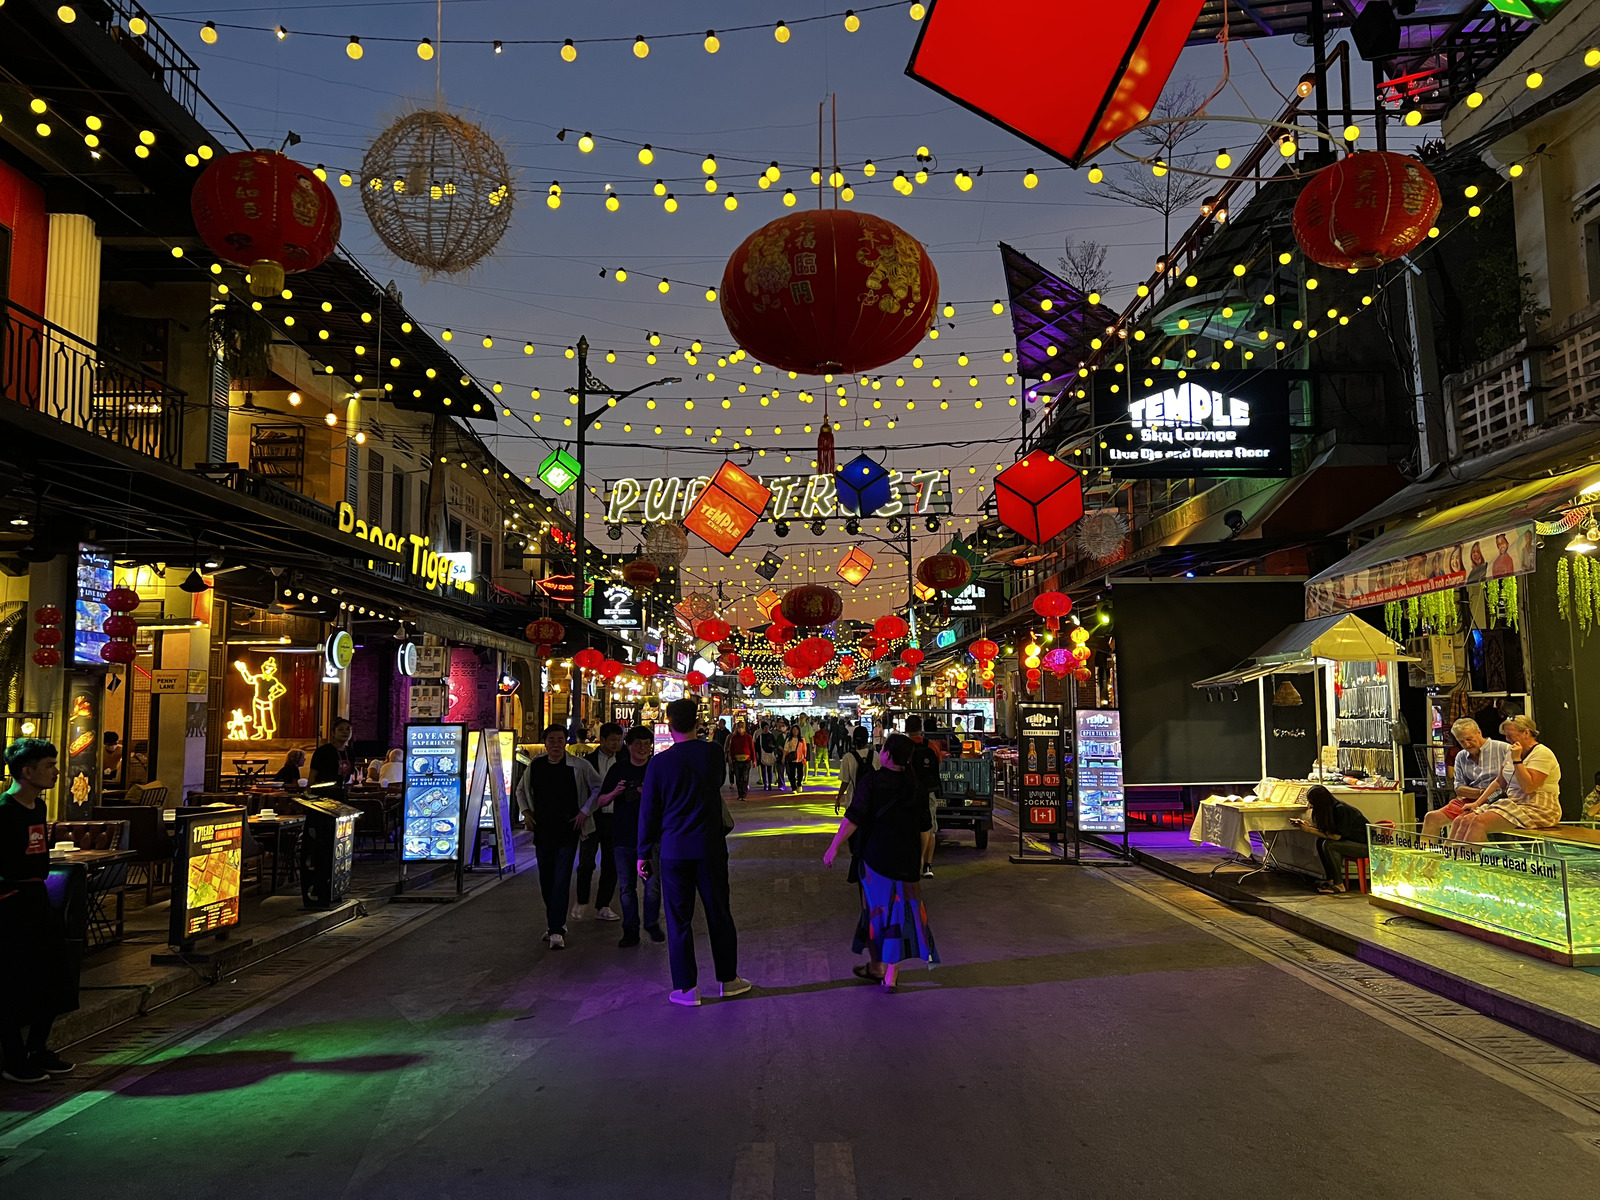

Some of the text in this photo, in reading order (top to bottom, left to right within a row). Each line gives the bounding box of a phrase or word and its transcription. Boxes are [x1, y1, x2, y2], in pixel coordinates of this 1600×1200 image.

[1128, 382, 1250, 428] TEMPLE
[1140, 428, 1236, 444] Sky Lounge
[1192, 448, 1233, 458] Dance
[757, 470, 941, 518] TRET
[700, 504, 742, 538] TEMPLE
[409, 533, 456, 590] Tiger
[940, 584, 986, 598] TPLE
[1384, 589, 1398, 600] make
[1398, 588, 1406, 600] you
[1407, 584, 1422, 596] happy
[1436, 578, 1444, 588] not
[1446, 574, 1464, 586] charge
[615, 708, 635, 719] BUY
[1025, 713, 1052, 723] TEMPLE
[1086, 714, 1113, 724] TEMPLE
[630, 719, 635, 728] 2
[1026, 776, 1040, 784] 1+1
[1034, 809, 1052, 822] 1+1
[1371, 830, 1557, 879] Please feed our hungry fish your dead skin!
